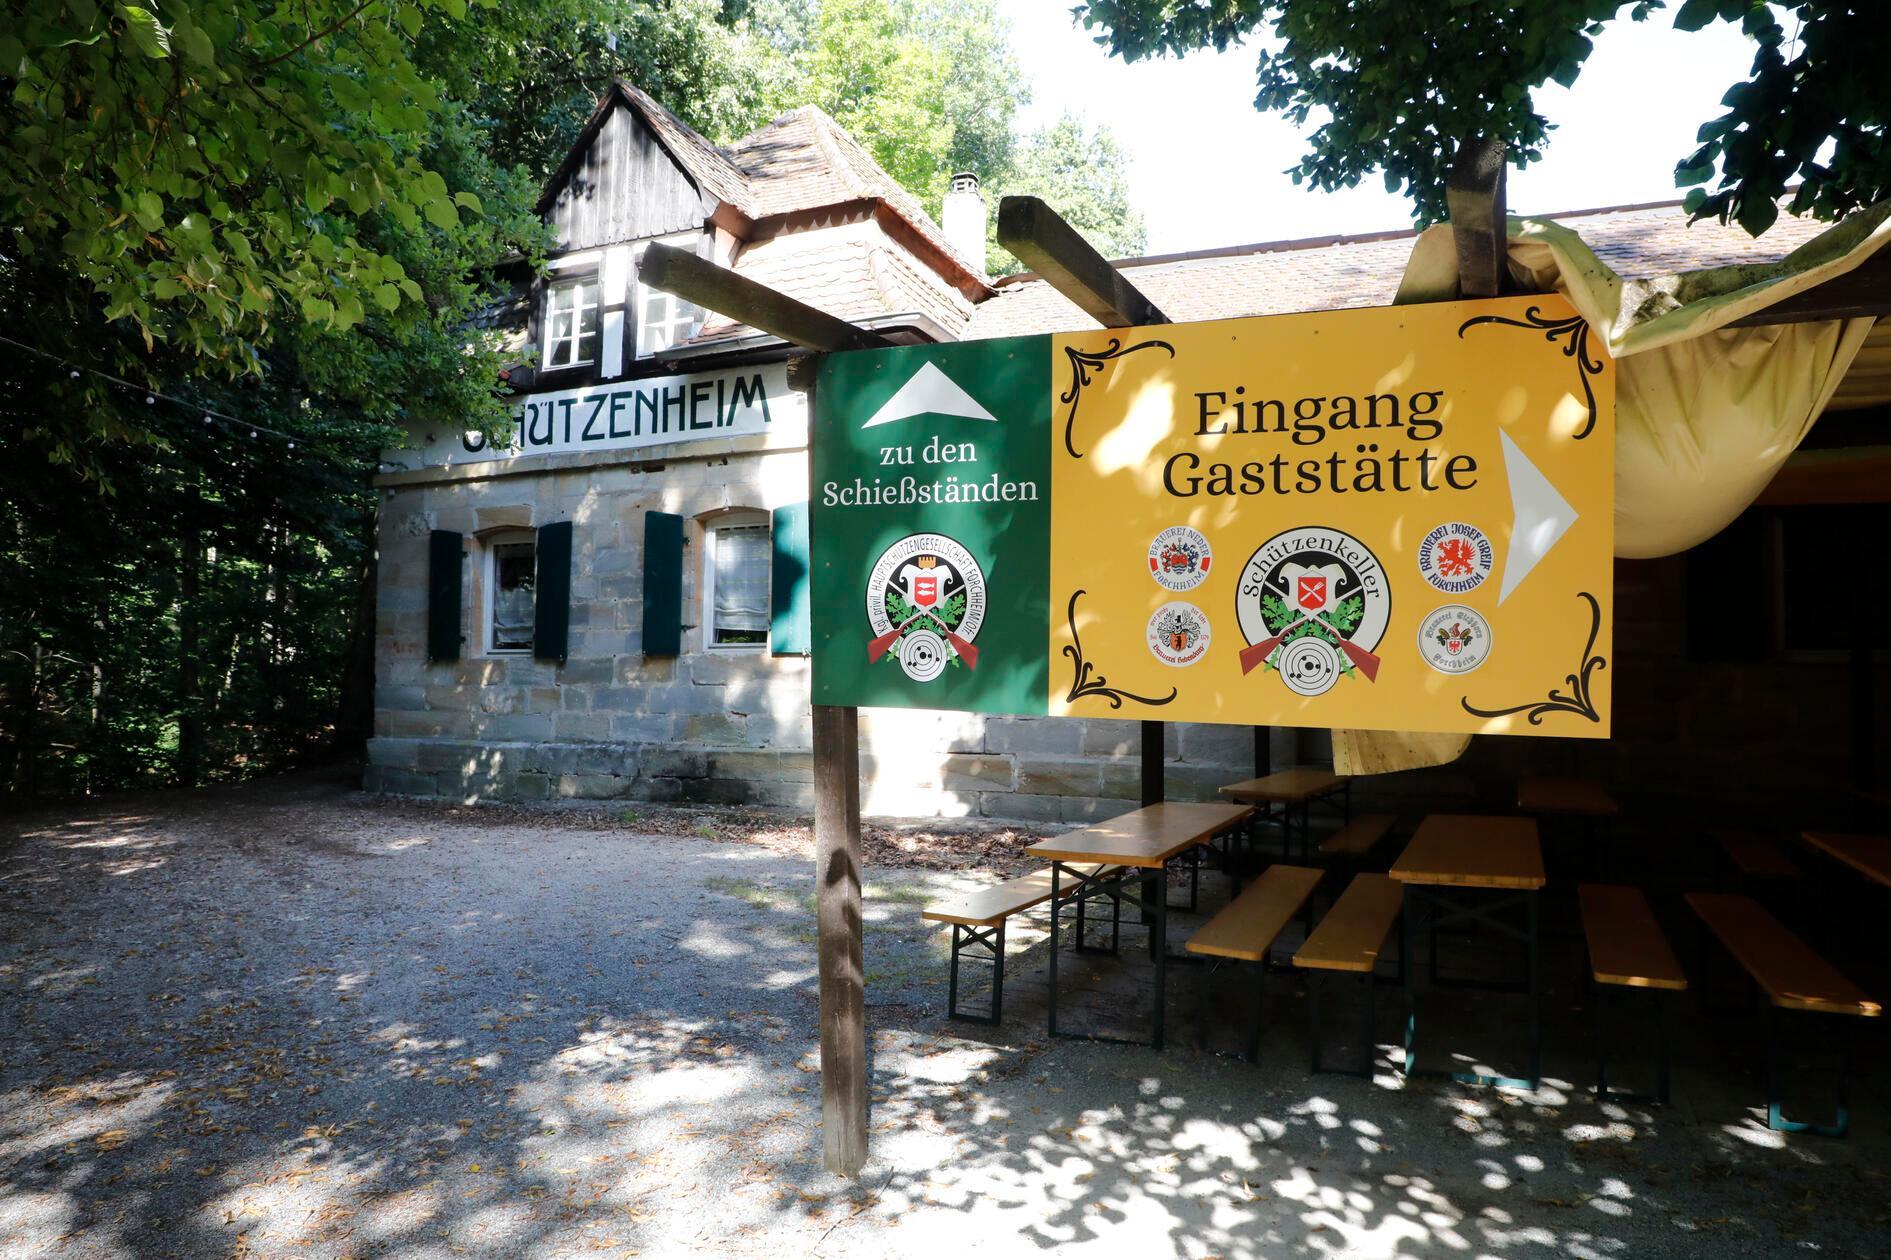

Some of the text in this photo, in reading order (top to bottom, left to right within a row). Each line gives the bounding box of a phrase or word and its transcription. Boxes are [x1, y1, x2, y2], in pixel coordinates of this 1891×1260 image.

[463, 374, 771, 453] HÜTZENHEIM
[1194, 386, 1444, 446] Eingang
[880, 435, 977, 466] zu den
[1163, 443, 1478, 497] Gaststätte
[823, 473, 1039, 507] Schießständen
[1149, 527, 1210, 557] BRAUEREI NEDER
[1419, 523, 1492, 571] BRAUEREI JOSEF GREIF
[1153, 571, 1205, 590] FORCHHEIM
[1243, 536, 1380, 598] Schützenkeller
[1427, 572, 1485, 593] FORCHHEIM
